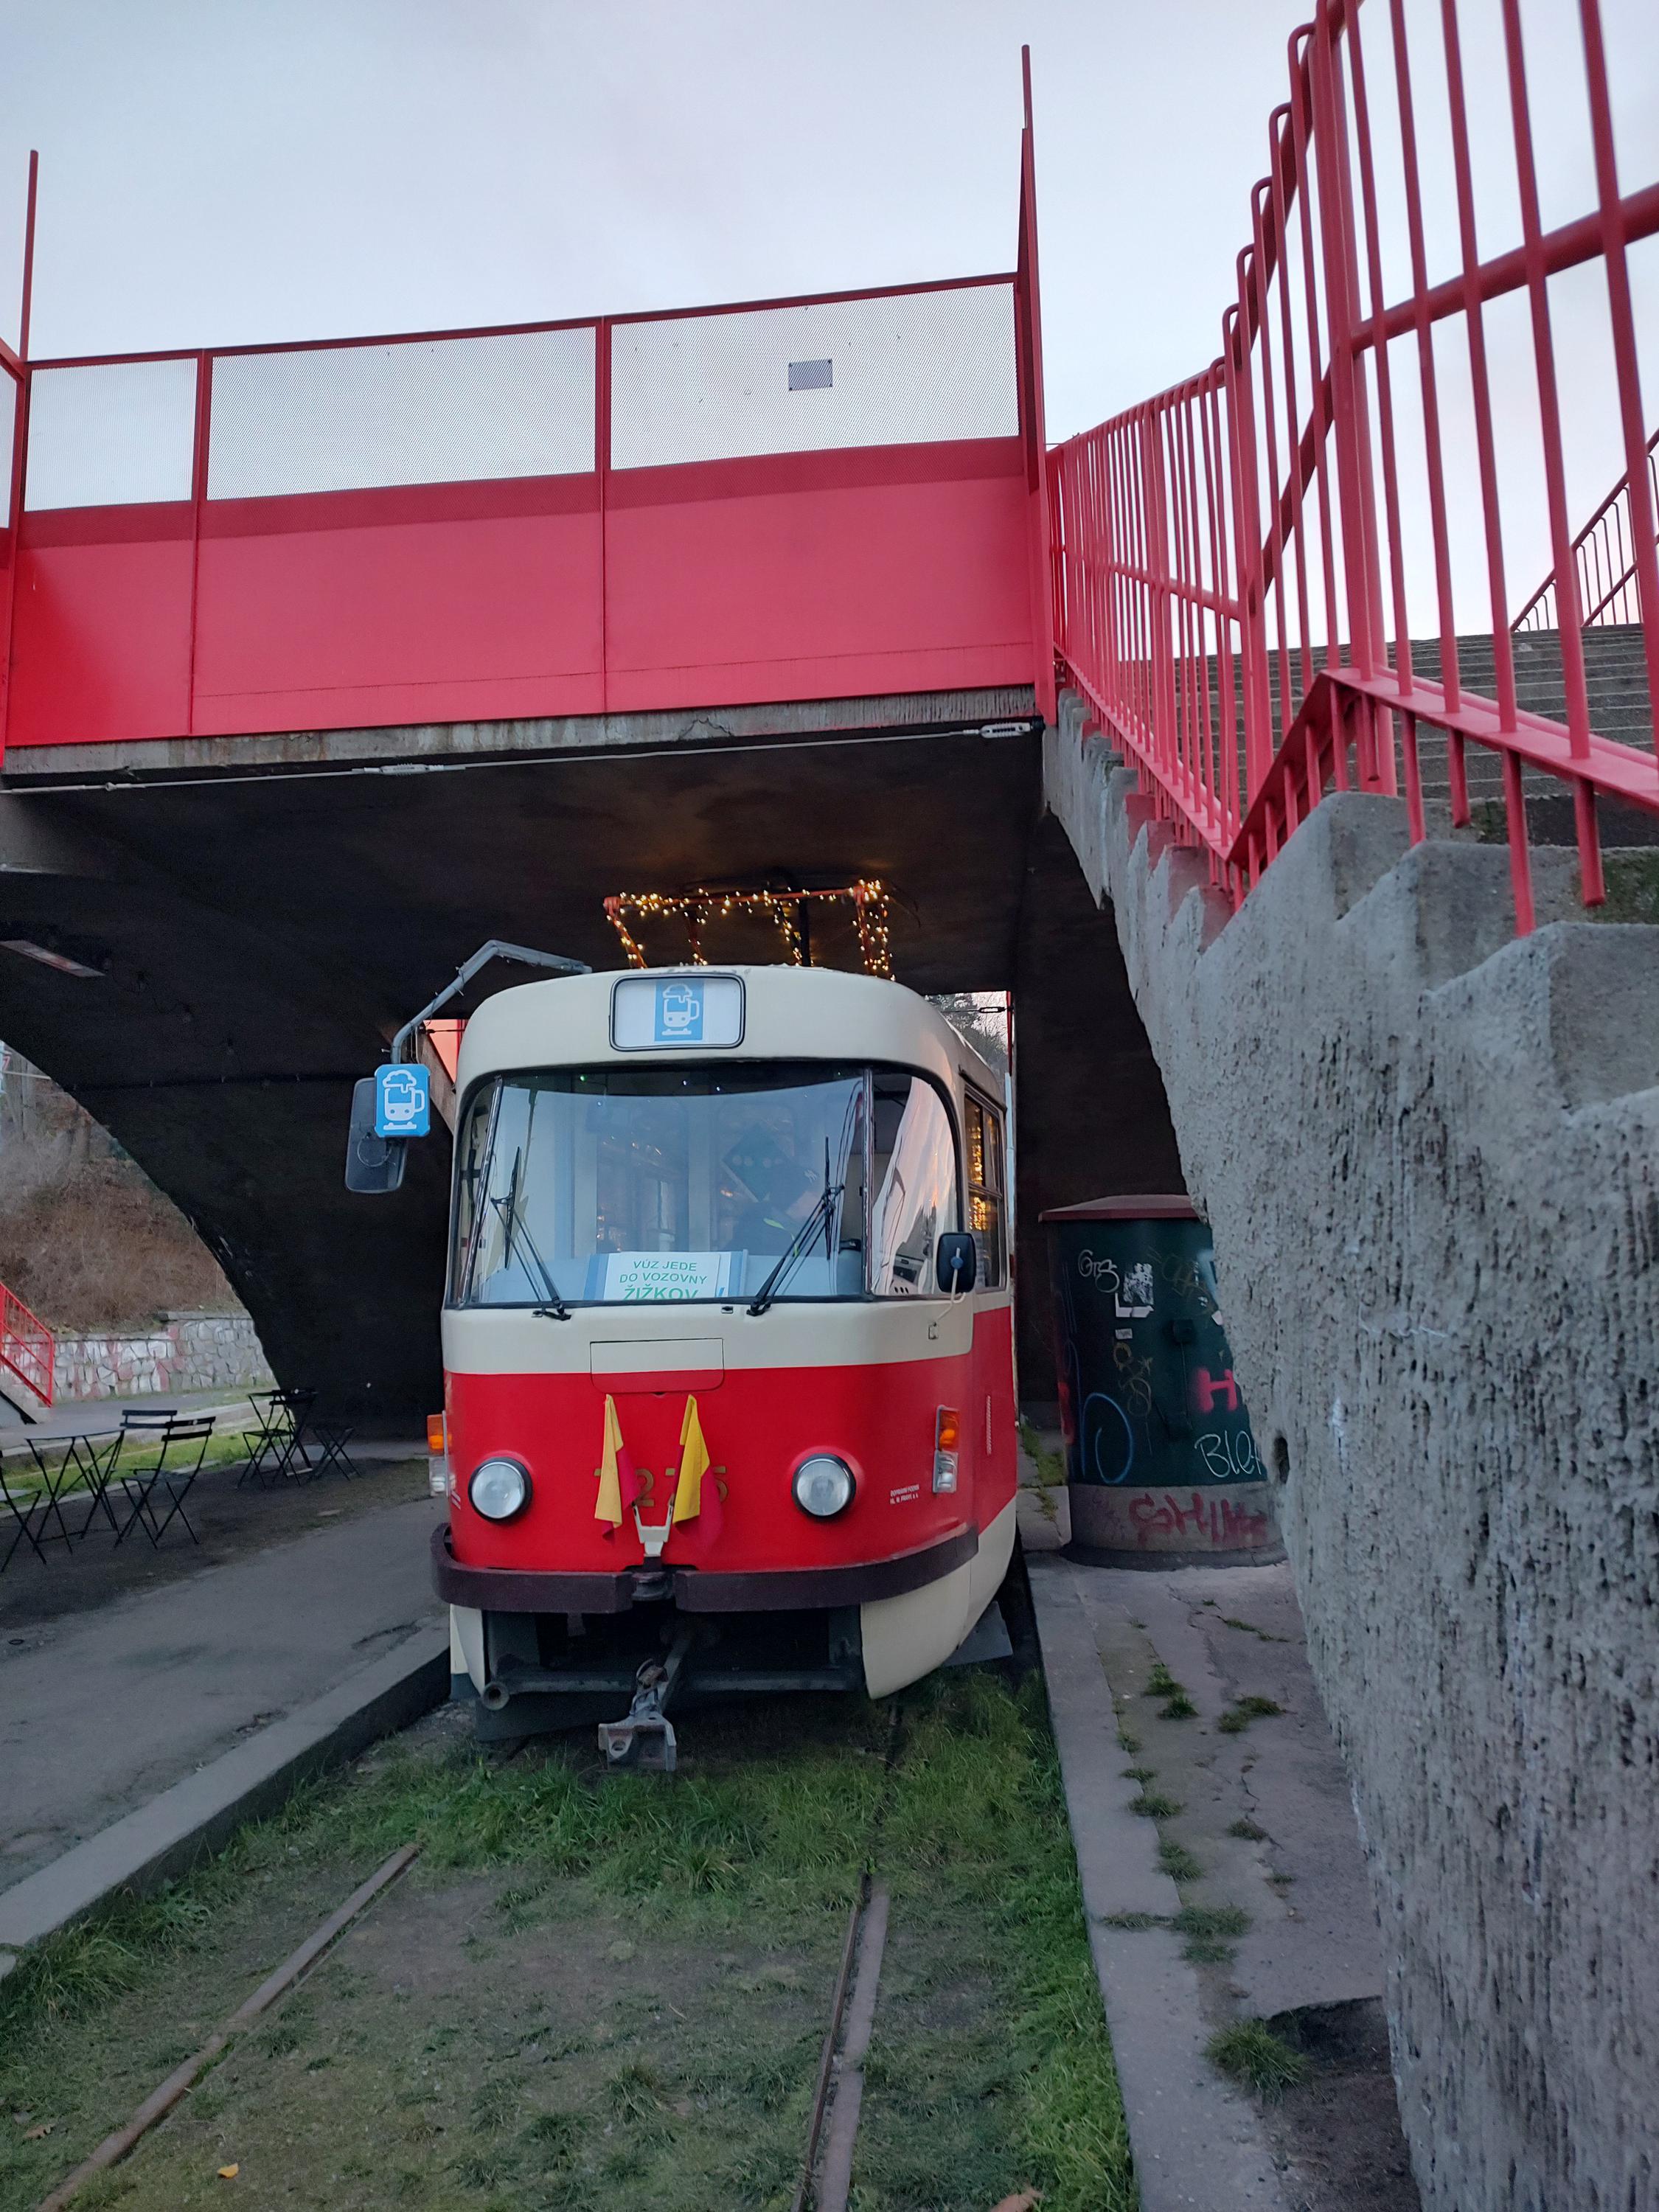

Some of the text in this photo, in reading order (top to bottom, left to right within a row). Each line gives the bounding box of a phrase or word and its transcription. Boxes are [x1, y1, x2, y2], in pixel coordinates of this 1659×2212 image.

[662, 1261, 698, 1271] JEDE
[619, 1273, 708, 1284] DO VOZOVNY
[623, 1284, 699, 1300] ŽIŽKOV
